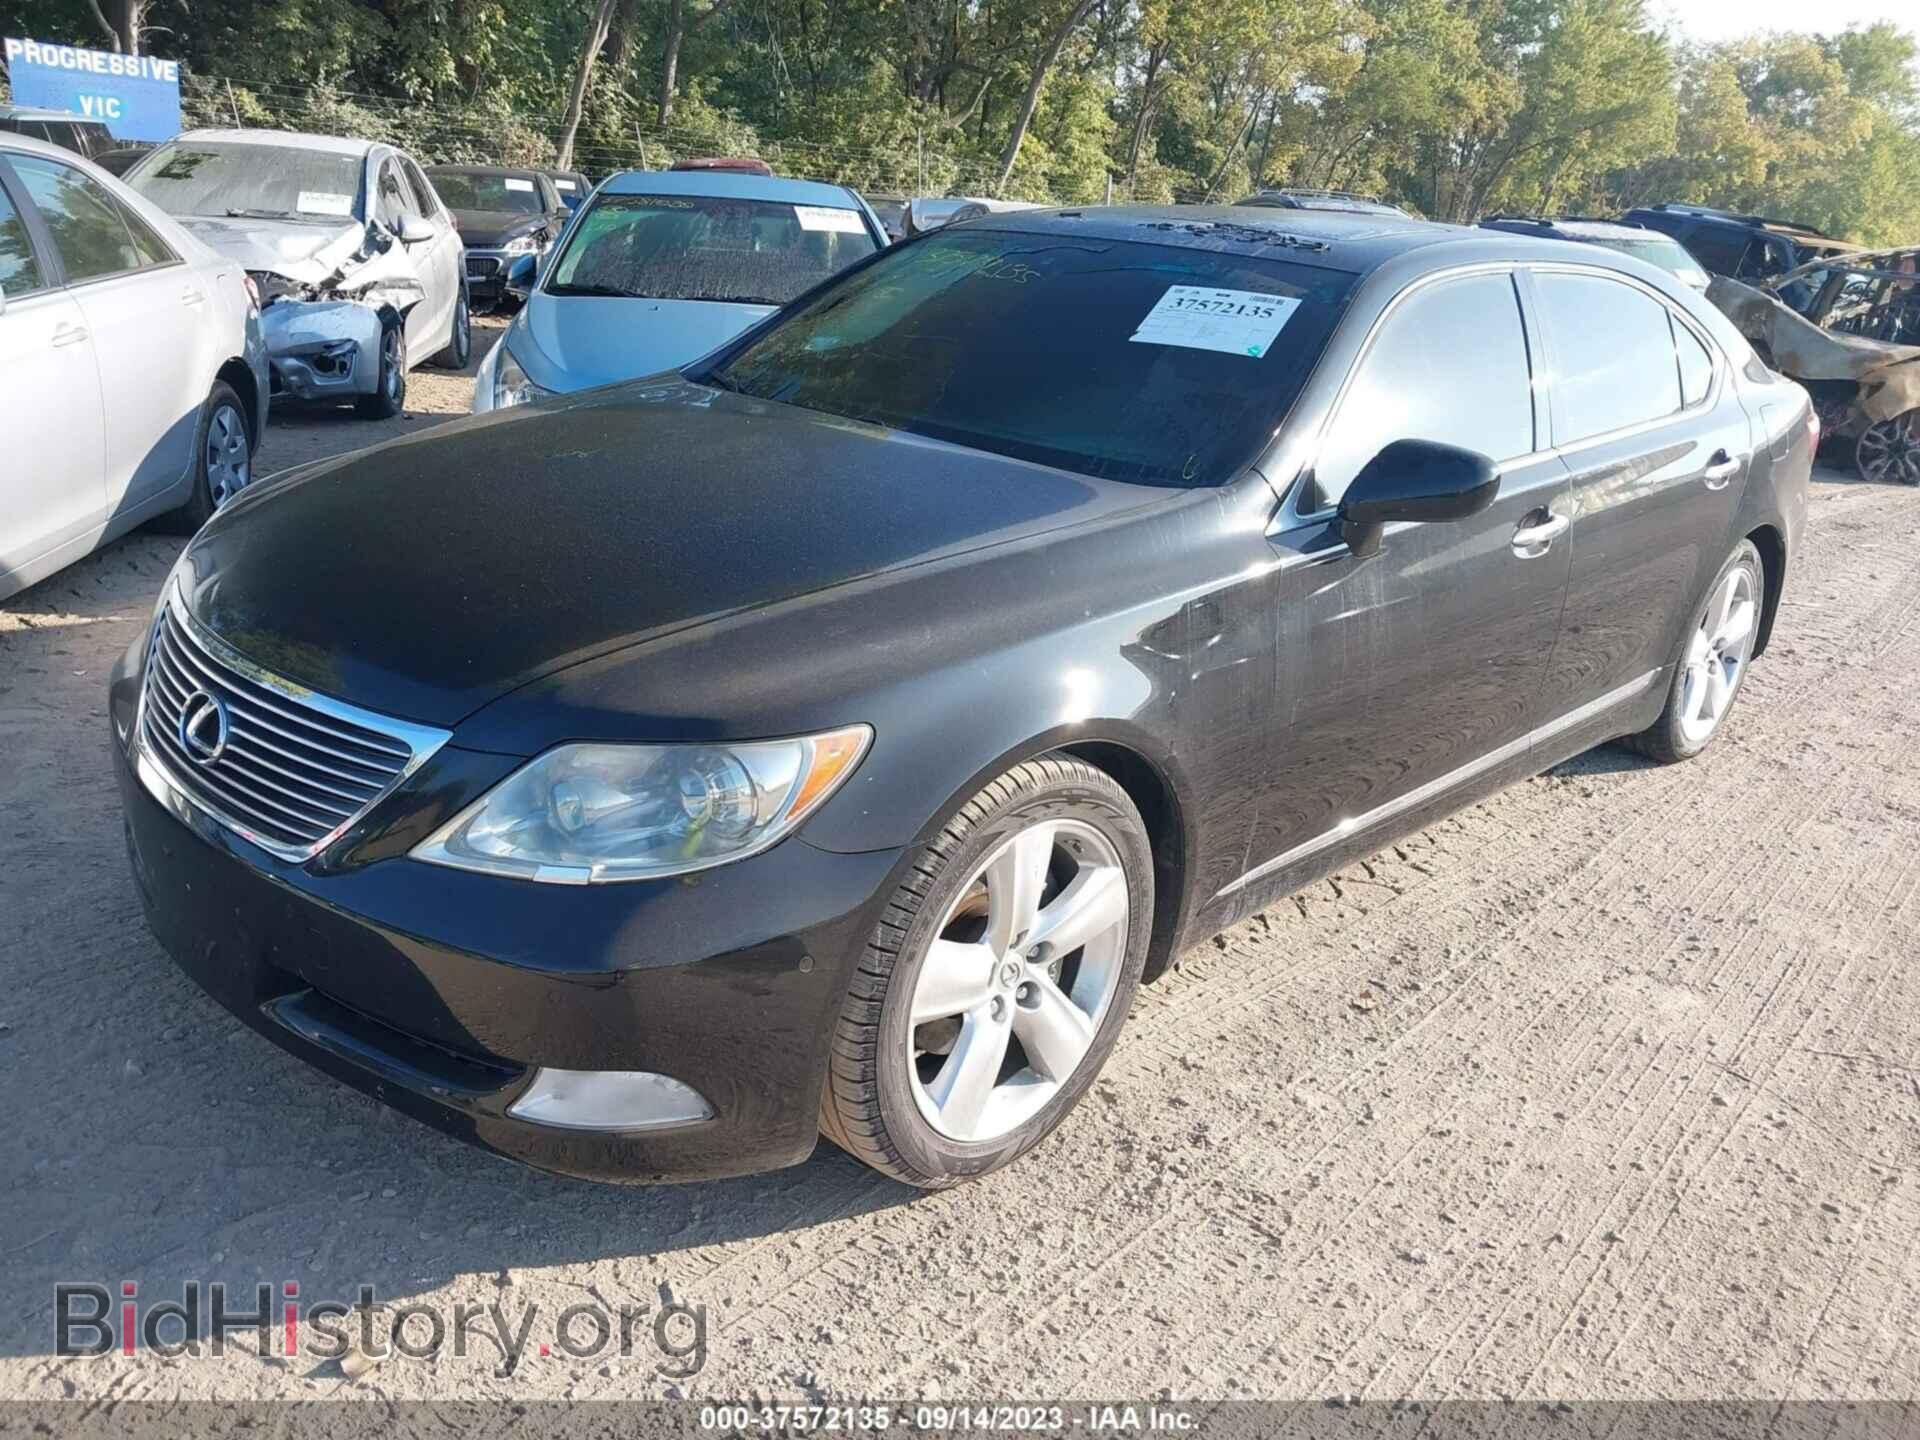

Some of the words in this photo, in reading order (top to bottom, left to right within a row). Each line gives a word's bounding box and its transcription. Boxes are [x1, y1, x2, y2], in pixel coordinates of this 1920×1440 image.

[5, 38, 178, 82] PROGRESSIVE
[79, 95, 121, 118] VIC
[1169, 297, 1275, 319] 37572135
